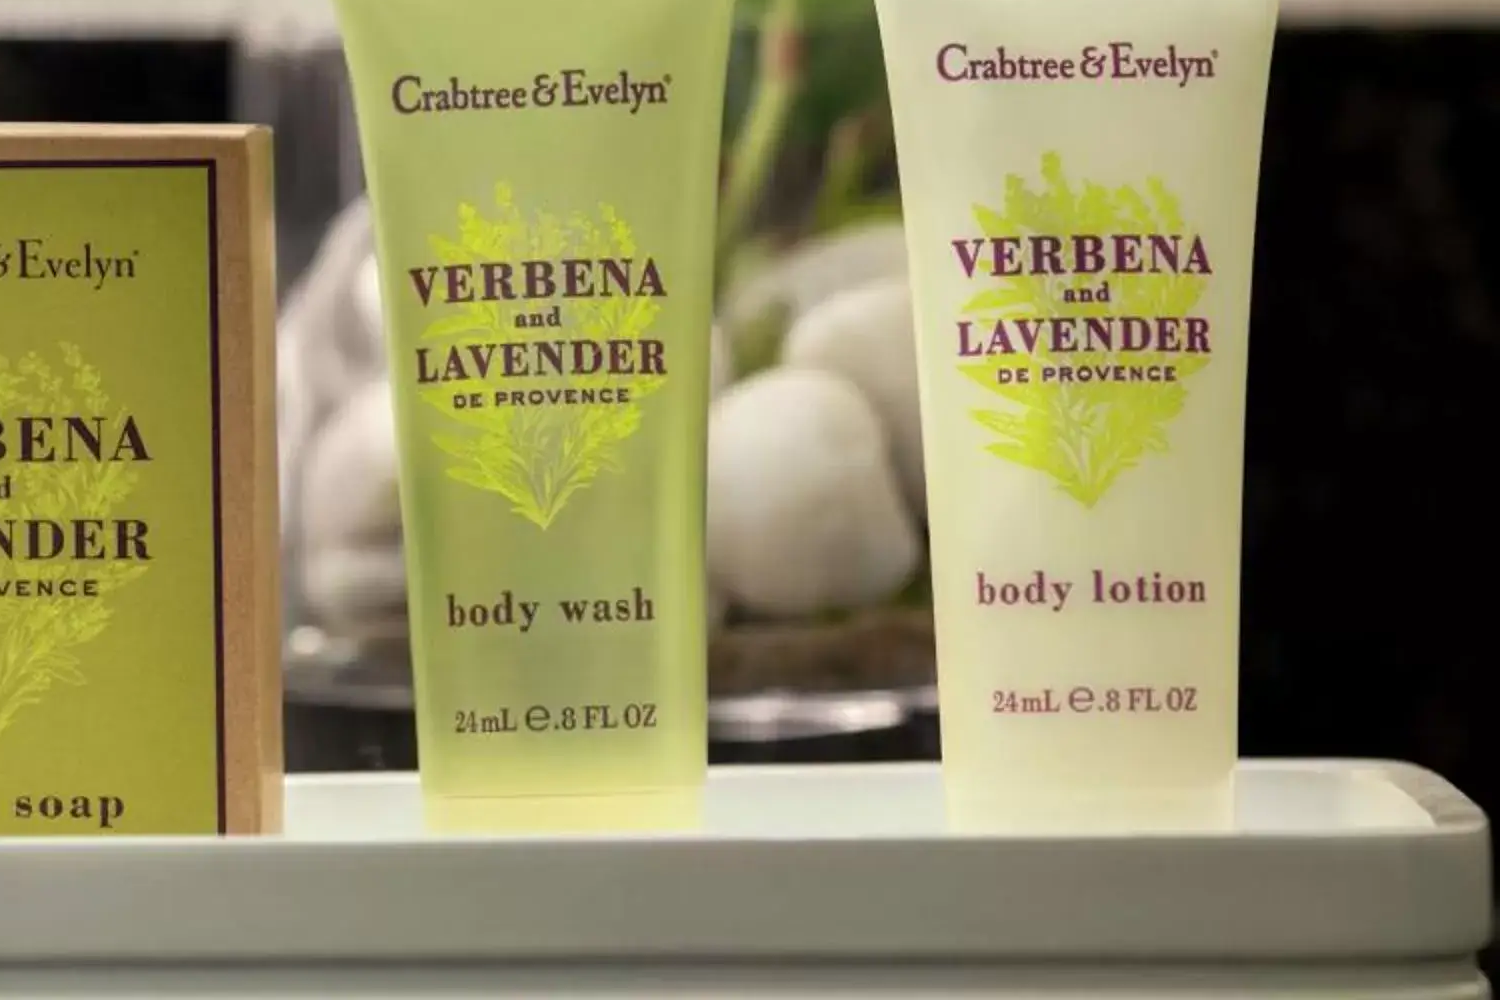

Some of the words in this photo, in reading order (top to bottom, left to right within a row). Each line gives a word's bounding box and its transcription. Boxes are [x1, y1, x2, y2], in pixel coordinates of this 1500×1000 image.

[936, 44, 1075, 82] Crabtree
[392, 75, 527, 114] Crabtree
[951, 234, 1213, 279] VERBENA
[408, 257, 668, 308] VERBENA
[1063, 281, 1111, 303] and
[514, 306, 562, 328] and
[956, 317, 1212, 357] LAVENDER
[415, 339, 668, 384] LAVENDER
[997, 368, 1029, 384] DE
[1042, 365, 1177, 382] PROVENCE
[453, 393, 483, 409] DE
[495, 388, 630, 407] PROVENCE
[446, 590, 540, 632] body
[560, 587, 655, 623] wash
[976, 570, 1073, 612] body
[1092, 570, 1206, 603] lotion
[455, 708, 517, 733] 24mL
[581, 705, 618, 729] FL
[624, 704, 657, 728] OZ
[992, 689, 1060, 713] 24mL
[1126, 687, 1162, 712] FL
[1166, 687, 1197, 712] OZ
[14, 795, 125, 828] soap
